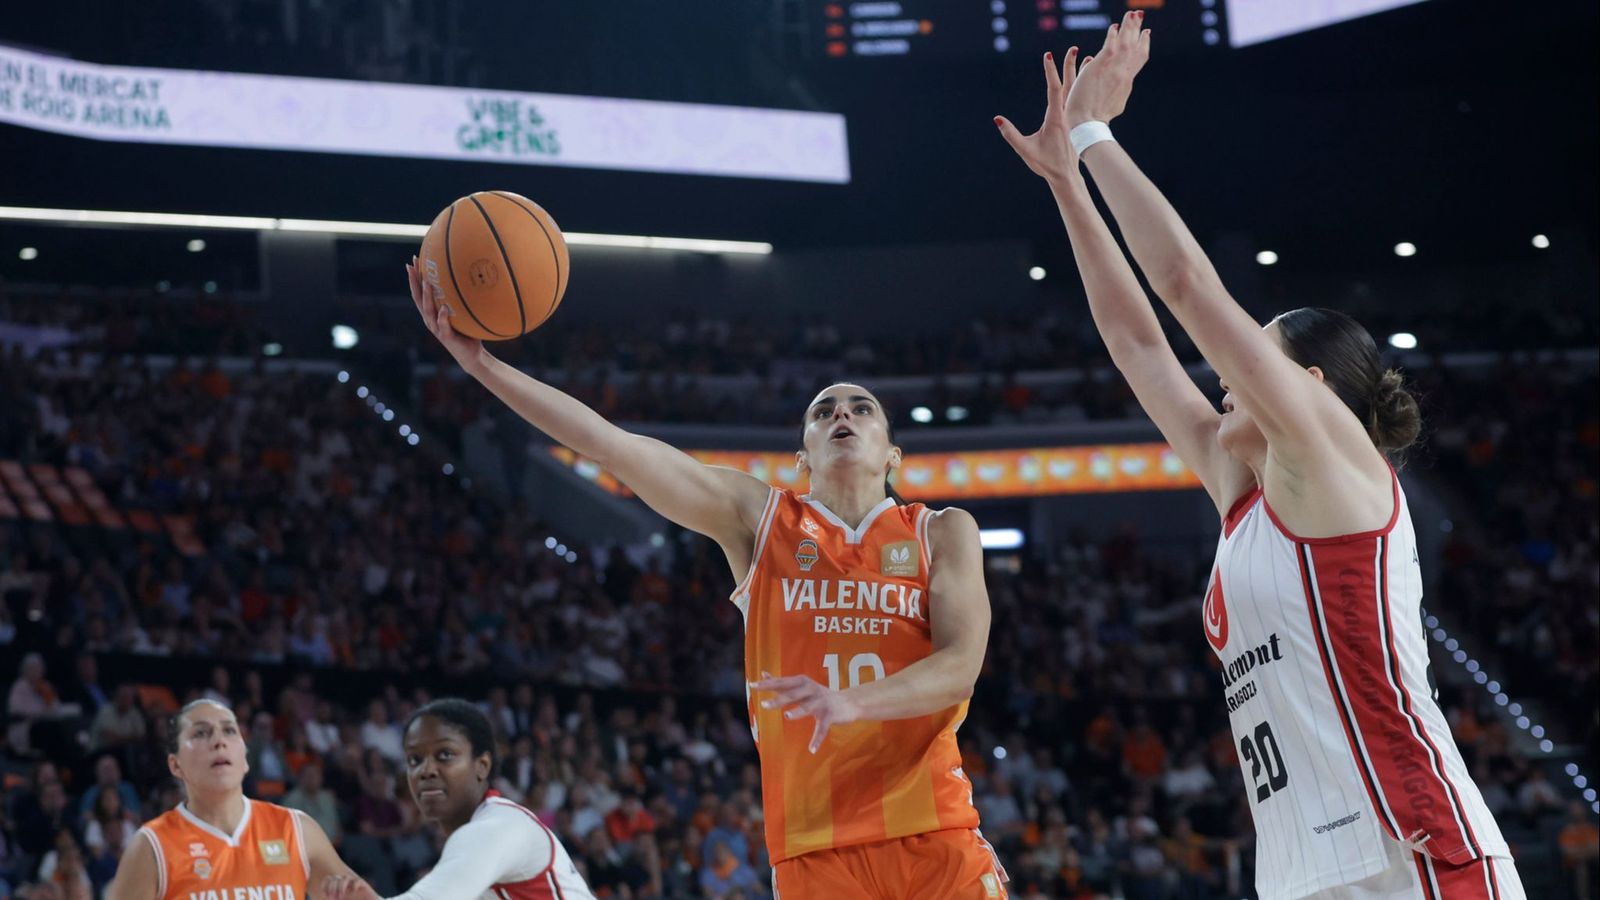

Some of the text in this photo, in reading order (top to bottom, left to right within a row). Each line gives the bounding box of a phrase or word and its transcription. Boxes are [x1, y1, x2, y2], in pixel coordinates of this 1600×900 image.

[28, 64, 49, 91] EL
[59, 69, 162, 102] MERCAT
[22, 91, 76, 122] ROIG
[82, 103, 172, 130] ARENA
[781, 577, 926, 621] VALENCIA
[814, 616, 893, 635] BASKET
[1240, 720, 1289, 804] 20
